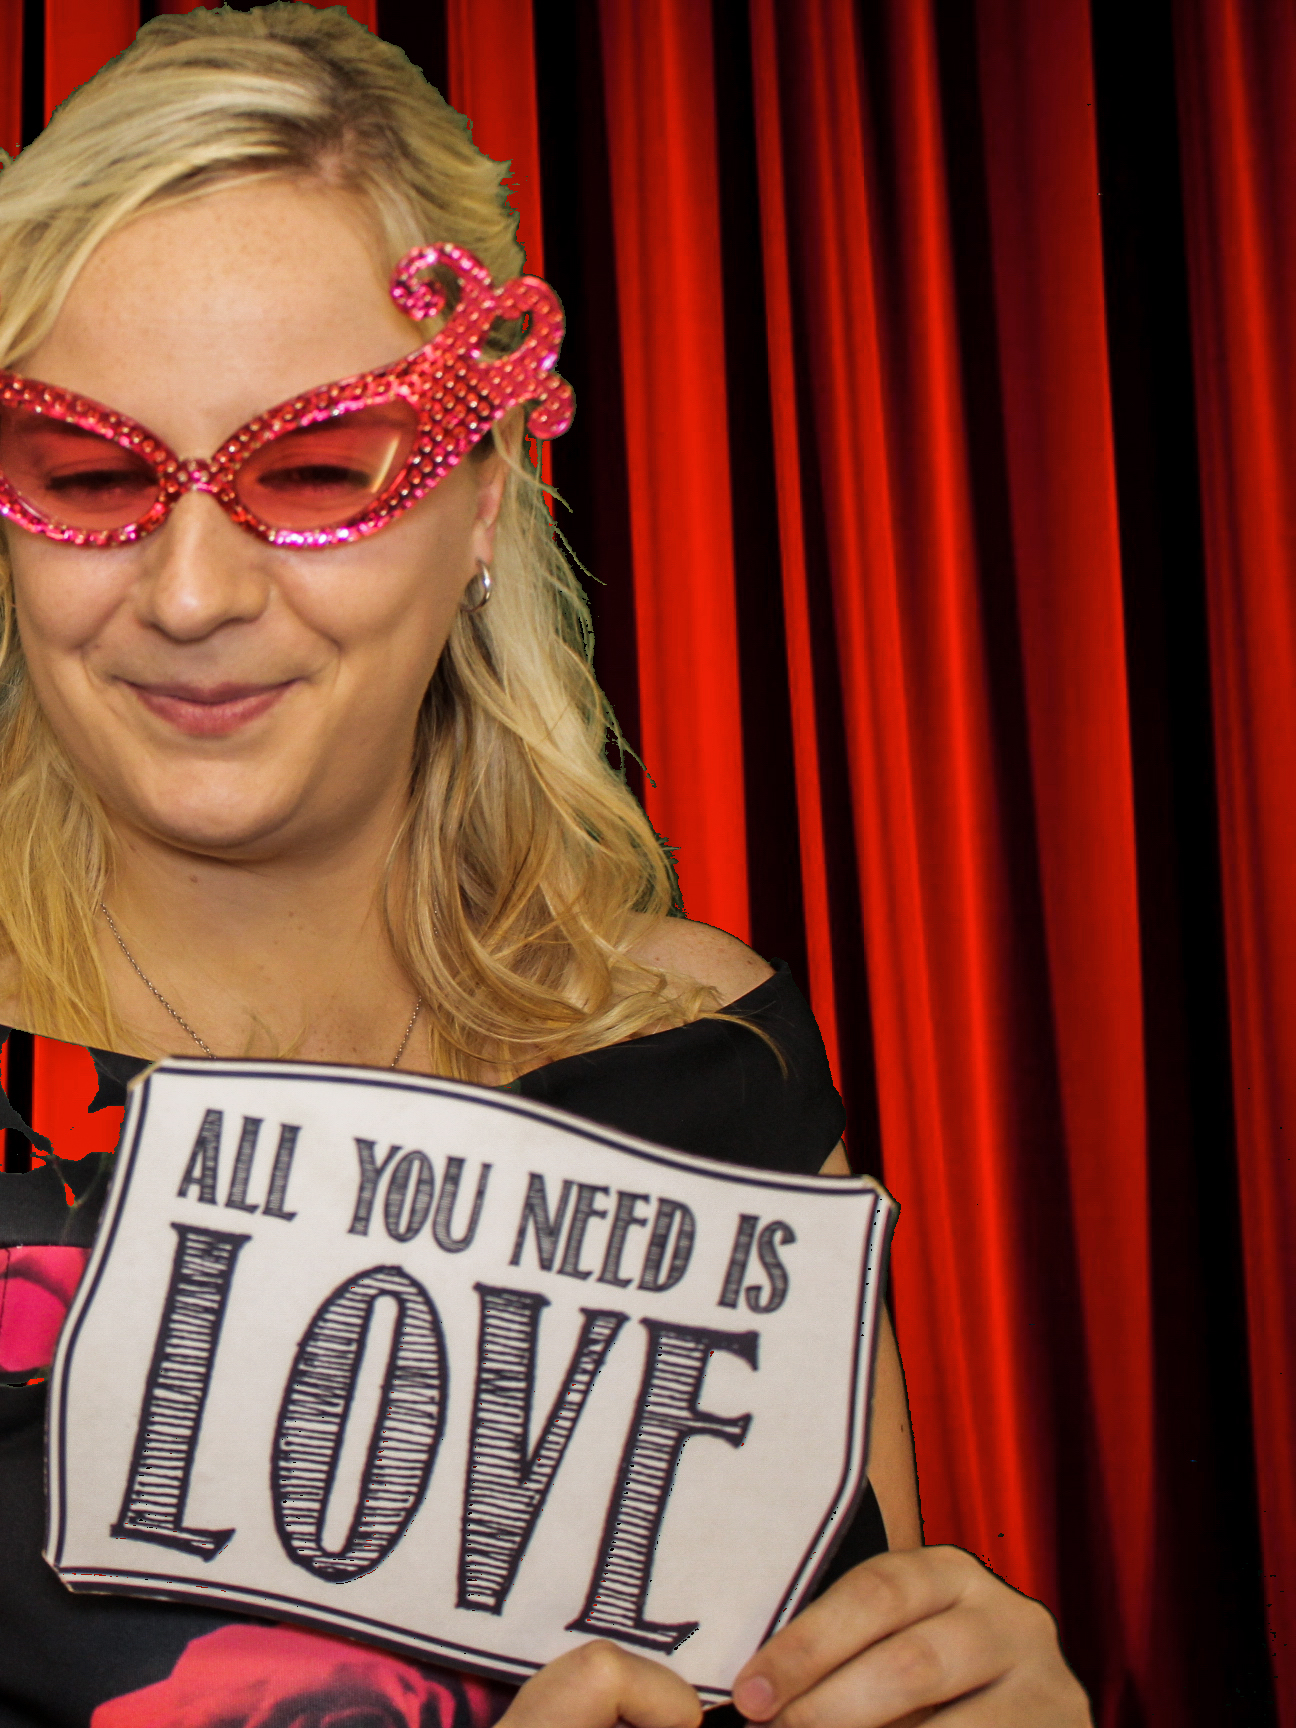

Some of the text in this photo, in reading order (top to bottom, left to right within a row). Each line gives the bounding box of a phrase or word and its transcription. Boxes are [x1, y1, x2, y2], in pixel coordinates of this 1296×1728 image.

[176, 1107, 797, 1315] ALL YOU NEED IS
[109, 1220, 761, 1657] LOVE
